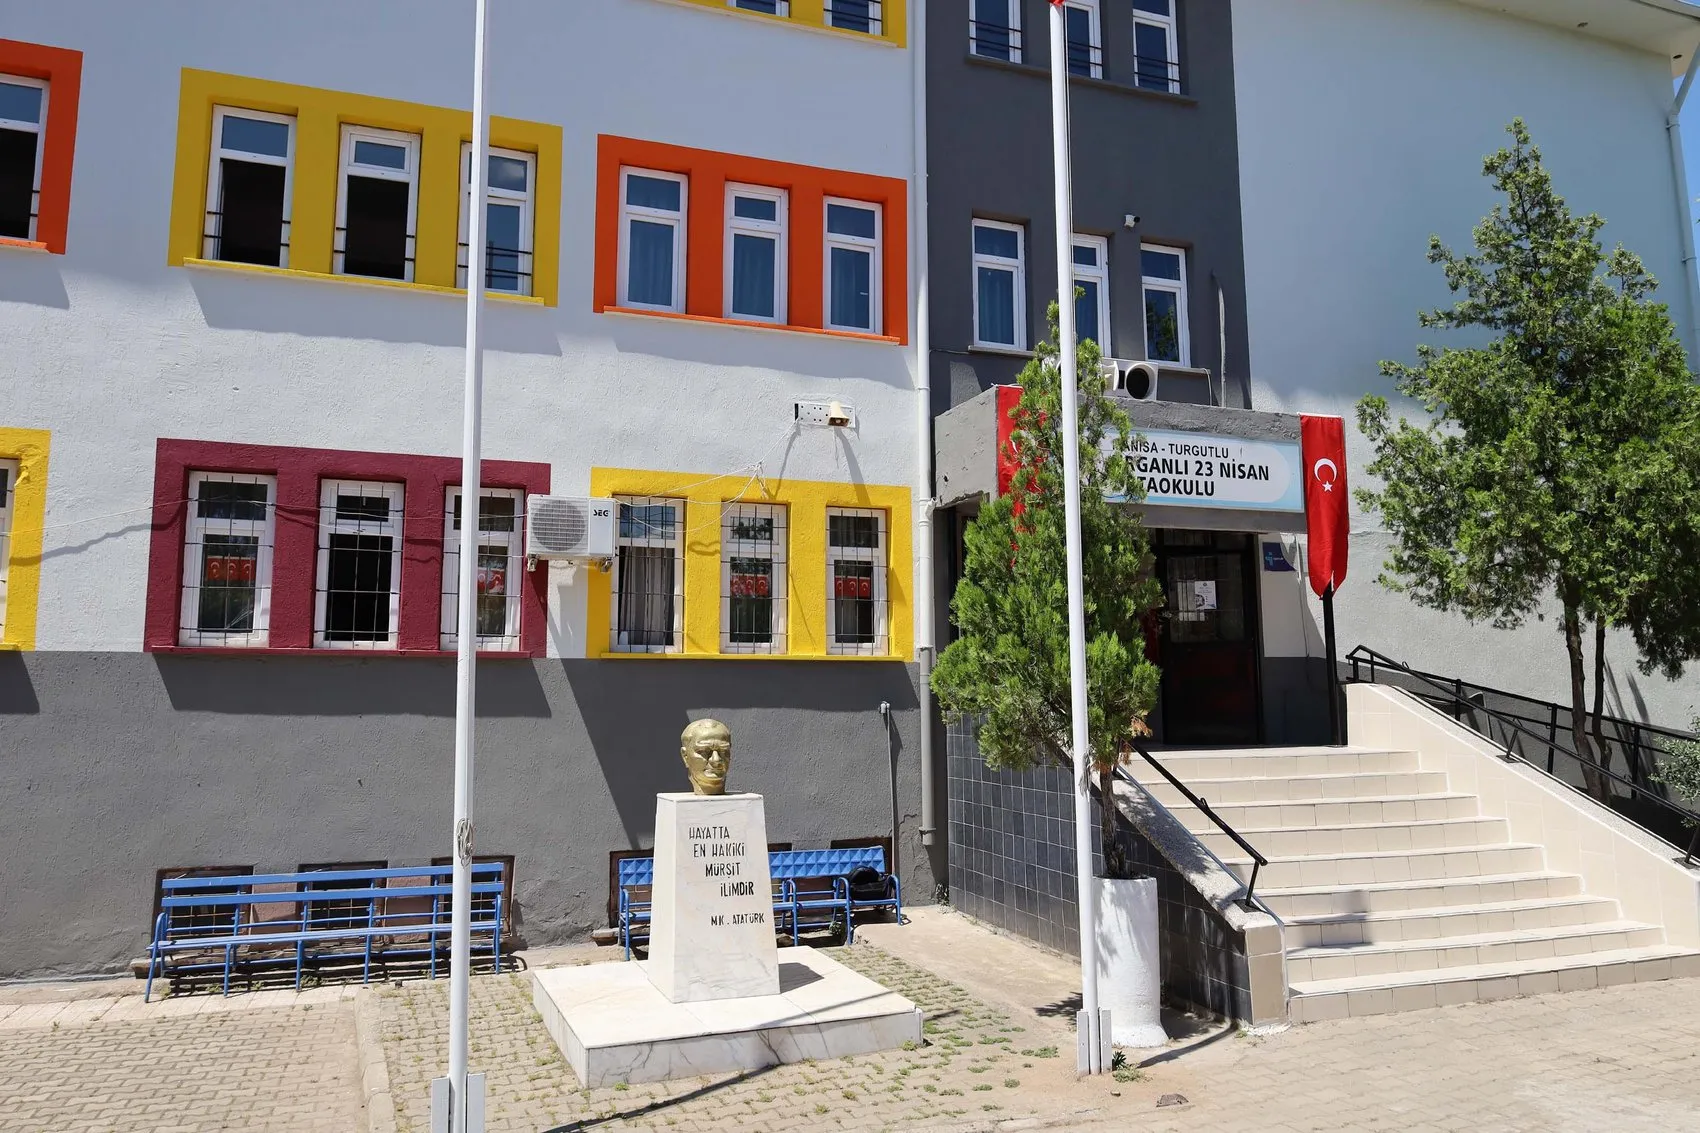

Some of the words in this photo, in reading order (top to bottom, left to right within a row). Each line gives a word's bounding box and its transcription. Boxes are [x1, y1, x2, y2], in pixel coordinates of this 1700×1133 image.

[1168, 443, 1229, 459] TURGUTLU
[1115, 455, 1189, 475] RGANLI
[1195, 460, 1214, 477] 23
[1220, 458, 1269, 481] NİSAN
[1125, 476, 1215, 497] TAOKULU
[593, 509, 609, 517] SEG
[689, 826, 730, 840] HAYATTA
[693, 843, 706, 858] EN
[712, 842, 745, 857] HAKİKİ
[705, 862, 741, 879] MÜRŞİT
[720, 881, 754, 897] İLİMDİR
[732, 912, 765, 925] ATATÜRK
